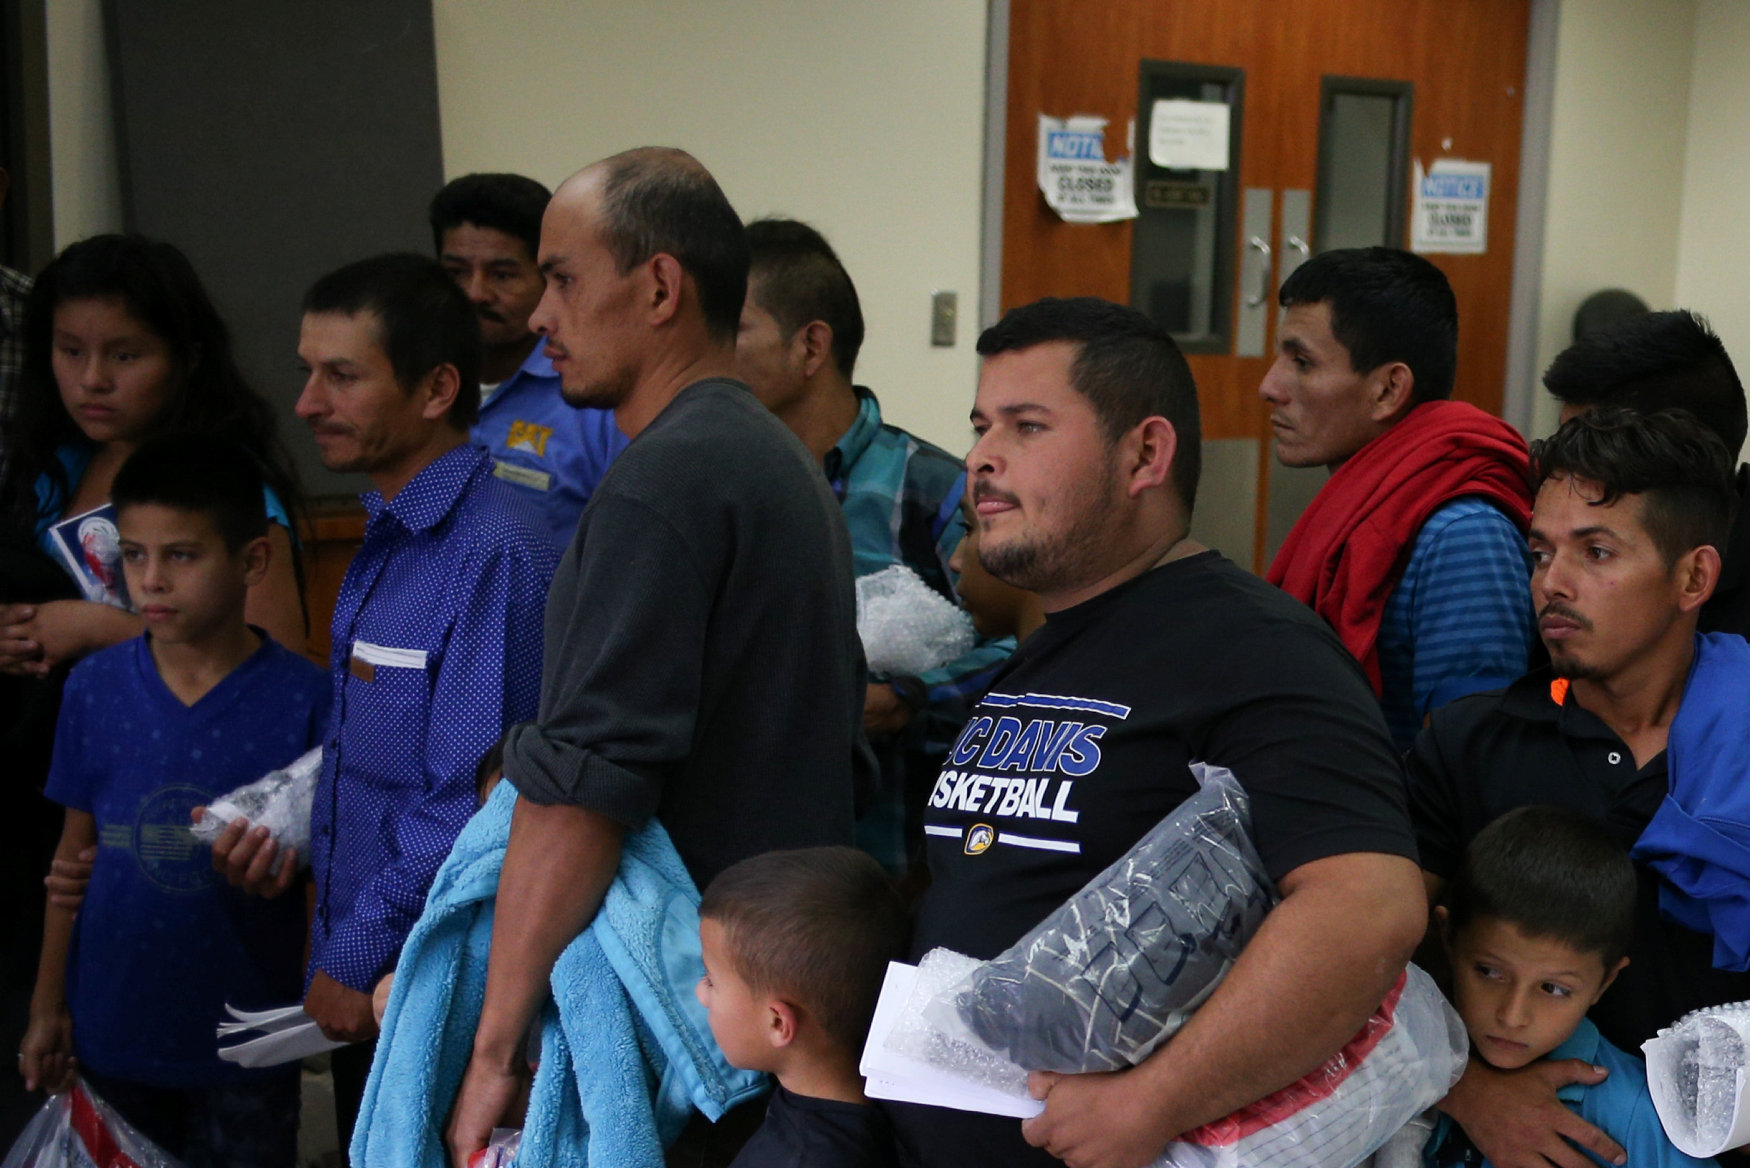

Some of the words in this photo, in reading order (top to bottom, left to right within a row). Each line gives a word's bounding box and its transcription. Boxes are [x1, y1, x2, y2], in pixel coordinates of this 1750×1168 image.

[1051, 138, 1103, 158] NOTI
[1057, 175, 1115, 192] CLOSED
[506, 419, 554, 457] CAT
[977, 716, 1108, 776] DAVIS
[928, 770, 1079, 824] SKETBALL
